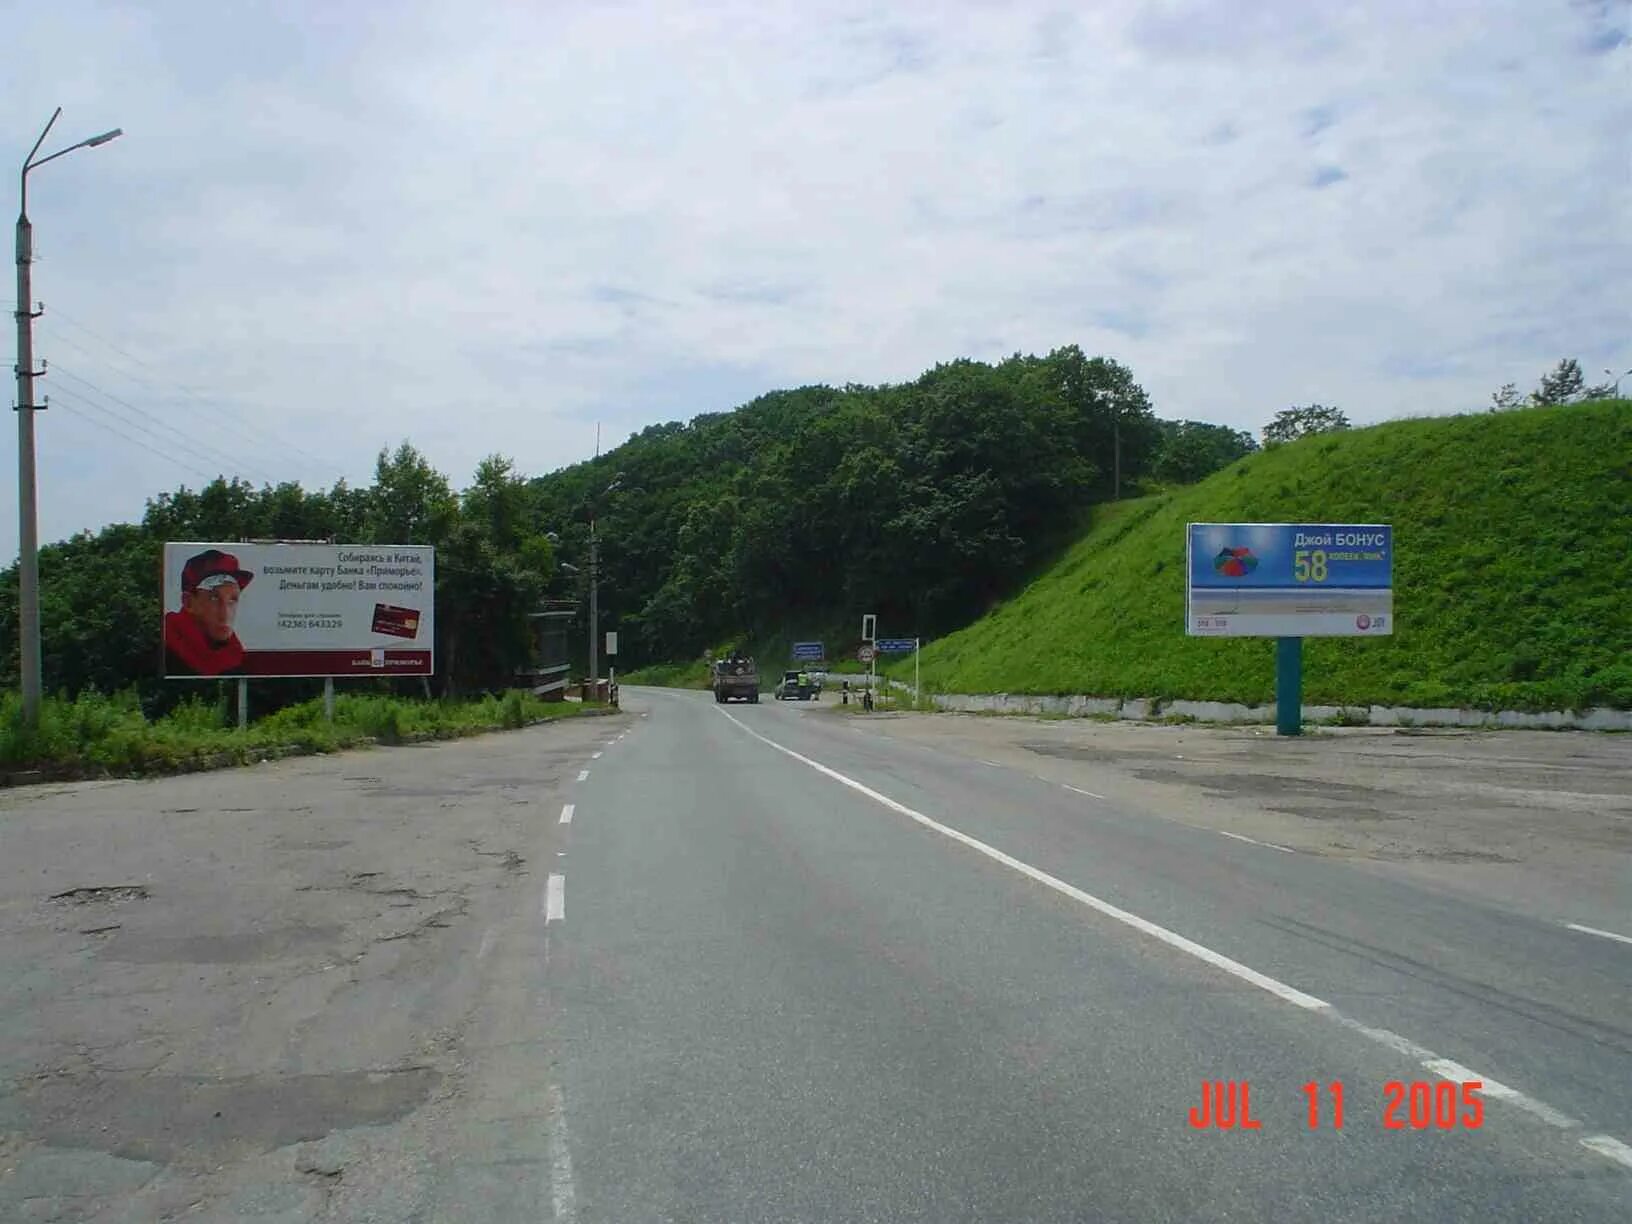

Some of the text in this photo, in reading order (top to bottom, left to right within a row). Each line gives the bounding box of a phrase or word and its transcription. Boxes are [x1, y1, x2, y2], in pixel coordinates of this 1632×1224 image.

[1294, 533, 1385, 548] Джой БОНУС
[338, 552, 385, 564] Собираясь
[386, 555, 393, 563] в
[263, 566, 308, 575] возьмите
[309, 566, 335, 578] карту
[337, 565, 364, 575] Банка
[1295, 550, 1328, 582] 58
[279, 579, 423, 592] Деньгам удобно! Вам спокойно!
